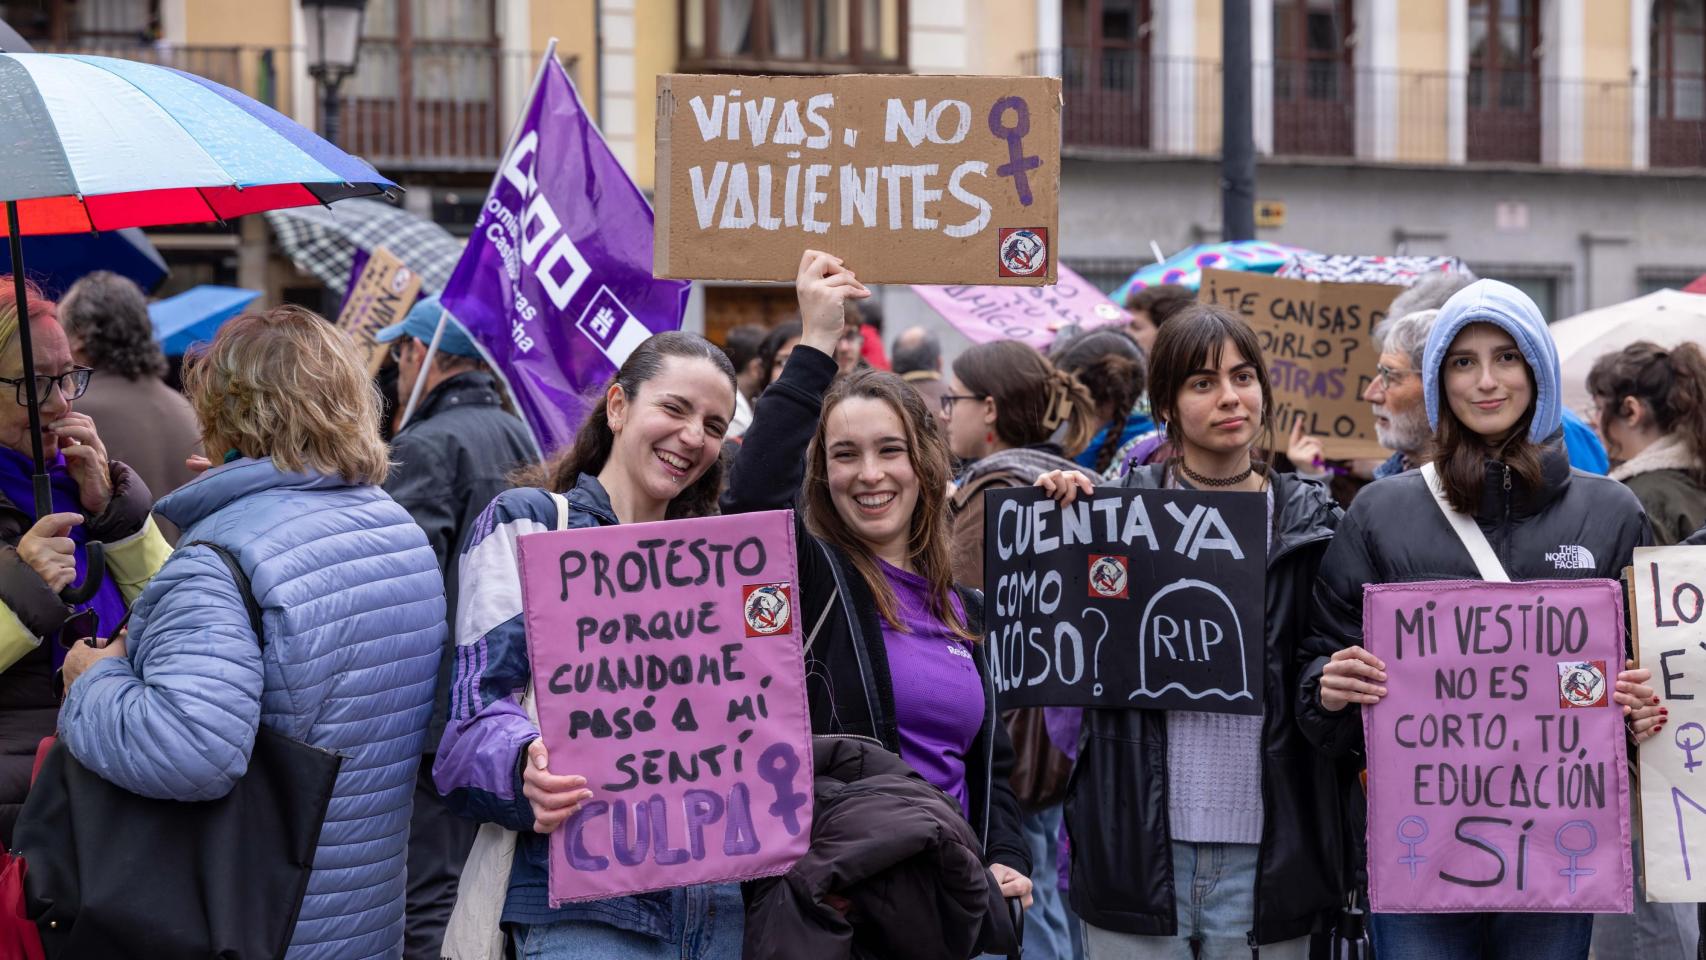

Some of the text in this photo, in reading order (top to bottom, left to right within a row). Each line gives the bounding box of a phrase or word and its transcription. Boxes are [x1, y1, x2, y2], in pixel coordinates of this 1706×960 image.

[885, 98, 972, 148] NO
[689, 151, 993, 238] VALIENTES
[1270, 297, 1361, 335] CANSAS
[997, 494, 1245, 561] CUENTA YA
[1545, 552, 1578, 562] NORTH
[1559, 545, 1578, 553] THE
[559, 536, 767, 601] PROTESTO
[996, 569, 1063, 618] COMO
[1554, 560, 1579, 569] FACE
[575, 602, 721, 652] PORQUE
[989, 607, 1109, 697] ACOSO?
[1454, 596, 1589, 656] VESTIDO
[568, 675, 773, 740] PASÓ A MÍ
[1435, 664, 1530, 701] NO ES
[601, 729, 753, 792] SENTÍ
[1414, 748, 1606, 810] EDUCACIÓN
[563, 782, 760, 872] CULPA
[1439, 815, 1535, 891] SÍ
